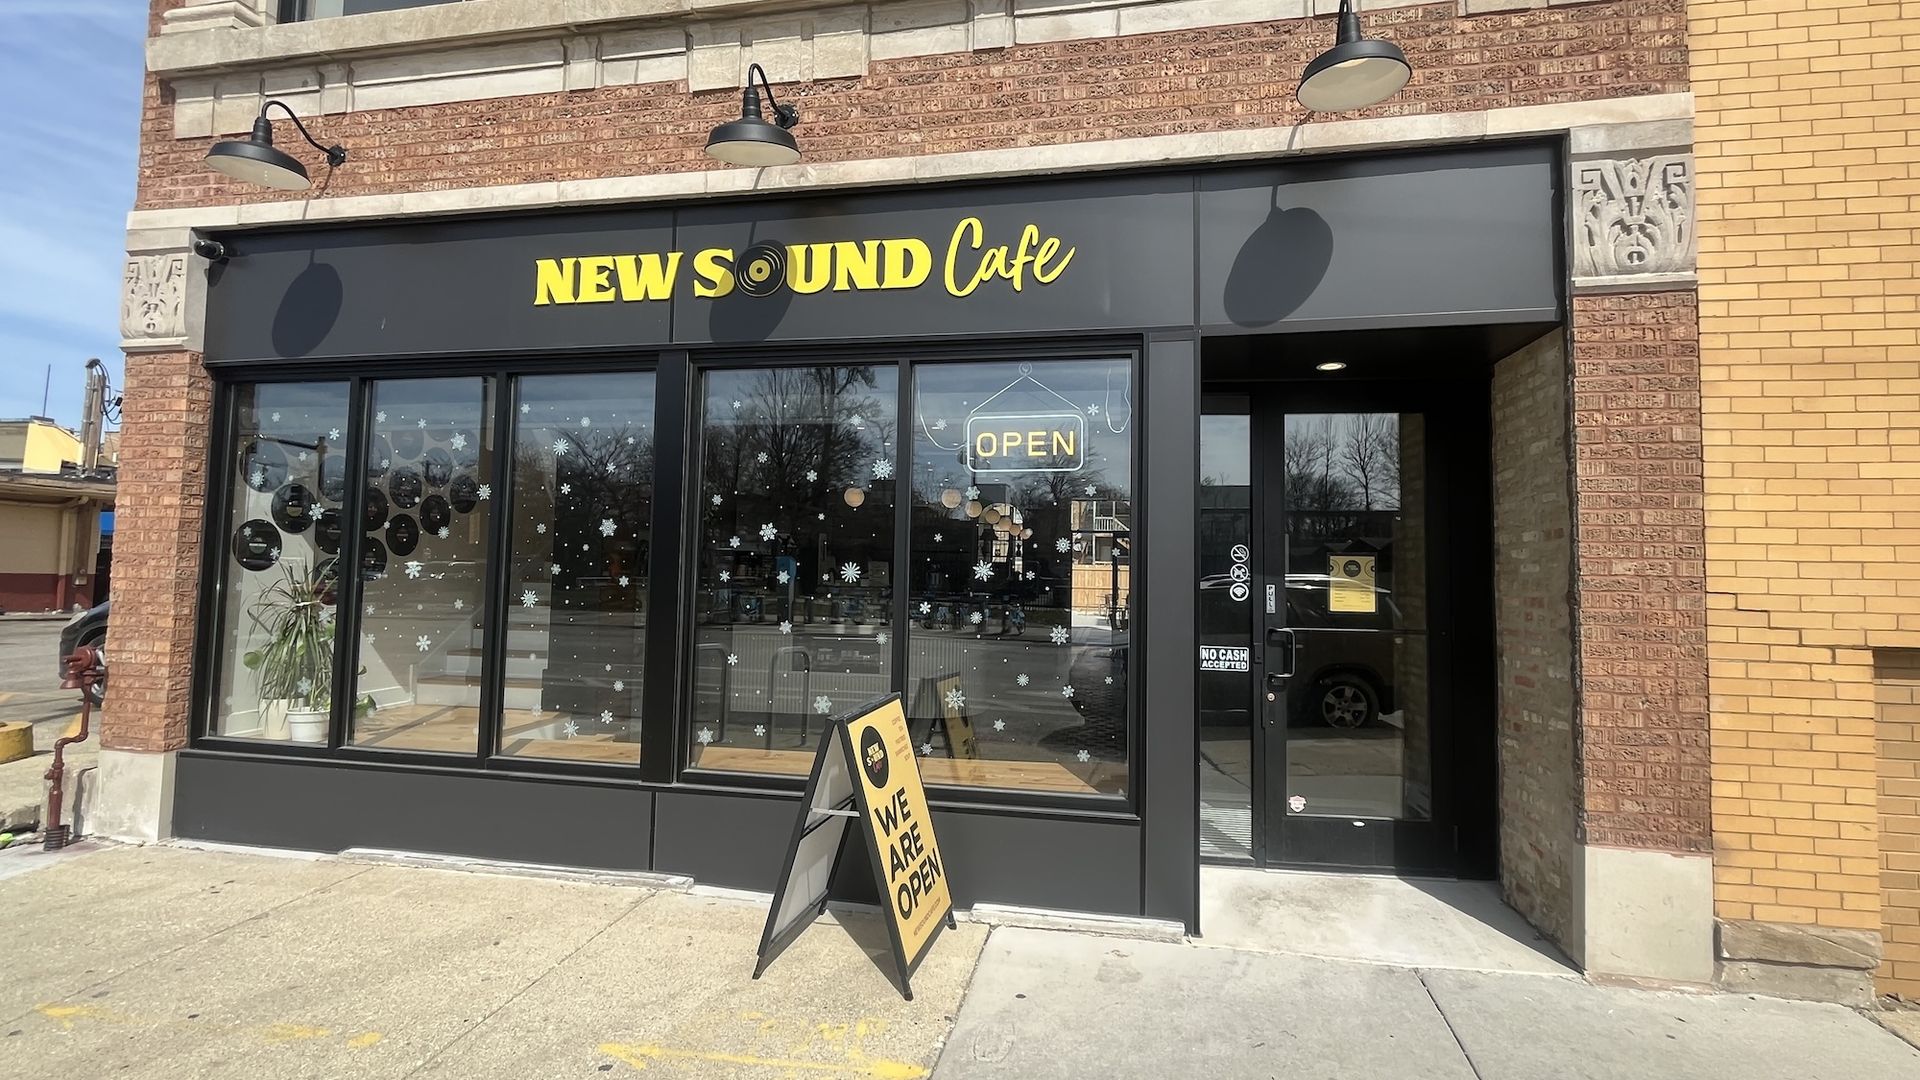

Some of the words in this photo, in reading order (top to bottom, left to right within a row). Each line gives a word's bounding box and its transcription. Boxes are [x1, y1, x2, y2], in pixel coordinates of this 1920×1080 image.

[534, 251, 684, 306] NEW
[944, 216, 1076, 297] Cafe
[976, 430, 1075, 457] OPEN
[1201, 648, 1217, 660] NO
[1218, 649, 1247, 661] CASH
[1201, 660, 1247, 670] ACCEPTED
[874, 787, 912, 838] WE
[889, 821, 924, 884] ARE
[897, 848, 941, 920] OPEN
